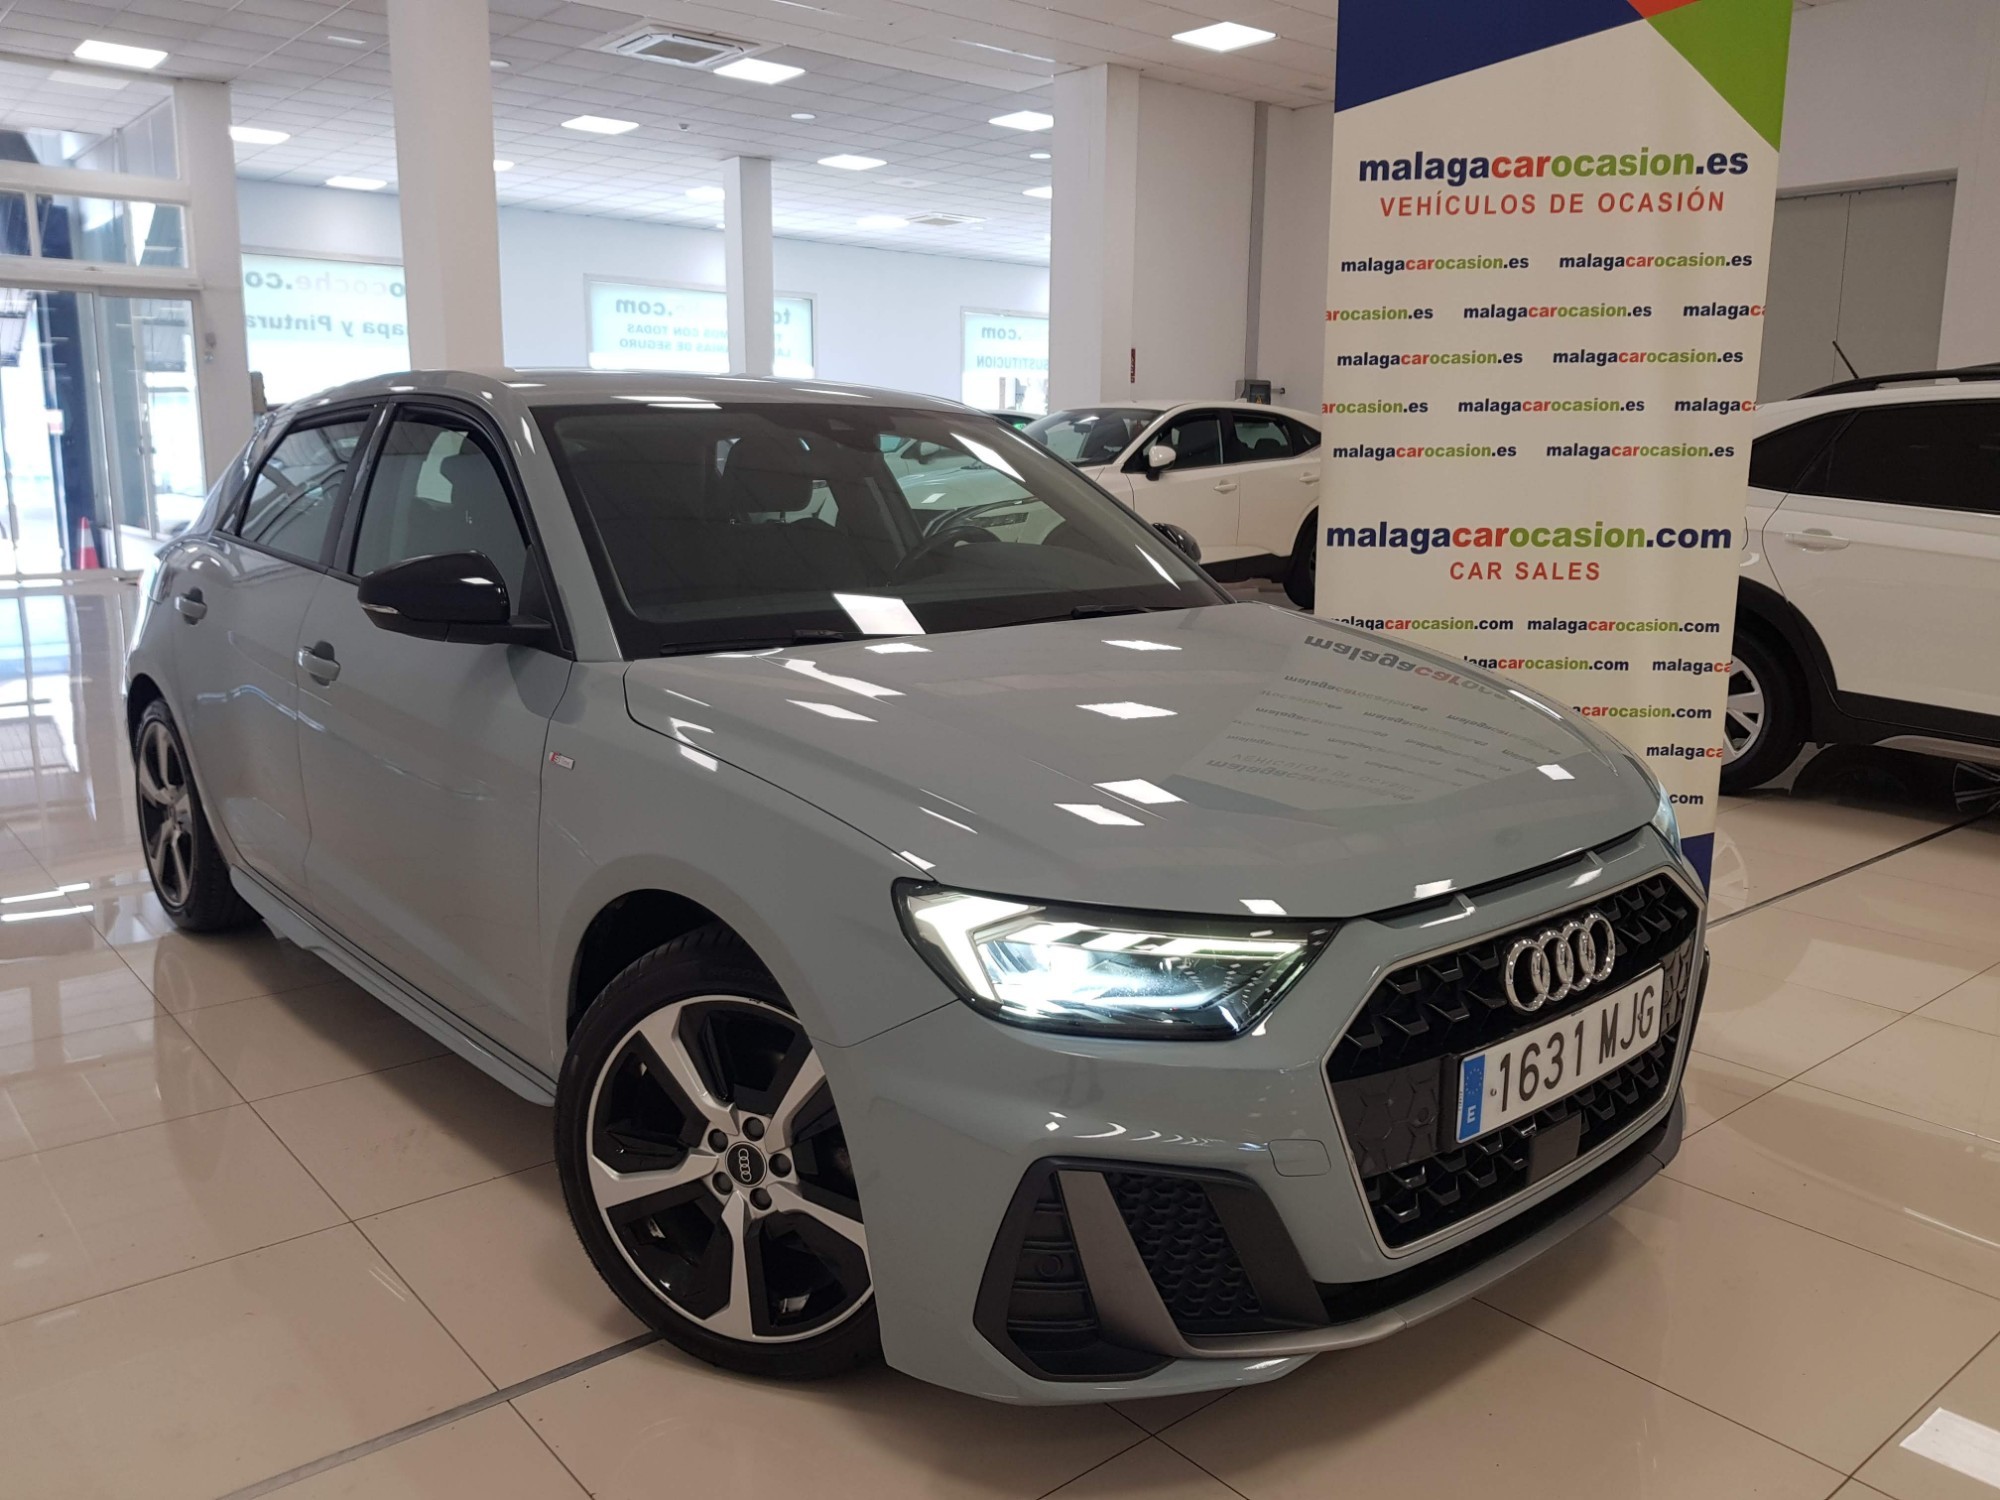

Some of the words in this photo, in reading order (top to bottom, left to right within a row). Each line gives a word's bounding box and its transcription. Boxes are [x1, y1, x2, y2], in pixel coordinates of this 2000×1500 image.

[1359, 147, 1748, 186] malagacarocasion.es
[1380, 190, 1536, 217] VEHÍCULOS
[1550, 193, 1584, 214] DE
[1598, 186, 1724, 213] OCASIÓN
[1341, 254, 1529, 275] malagacarocasion.es
[1559, 251, 1752, 271] malagacarocasion.es
[1463, 302, 1652, 322] malagacarocasion.es
[1337, 350, 1523, 369] malagacarocasion.es
[1553, 348, 1743, 366] malagacarocasion.es
[1458, 398, 1645, 415] malagacarocasion.es
[1333, 444, 1516, 461] malagacarocasion.es
[1546, 442, 1734, 460] malagacarocasion.es
[1326, 521, 1732, 554] malagacarocasion.com
[1449, 562, 1502, 581] CAR
[1515, 562, 1600, 581] SALES
[1527, 617, 1720, 634] malagacarocasion.com
[1500, 1020, 1584, 1112] 1631
[1599, 985, 1655, 1065] MJG
[1467, 1105, 1476, 1124] E
